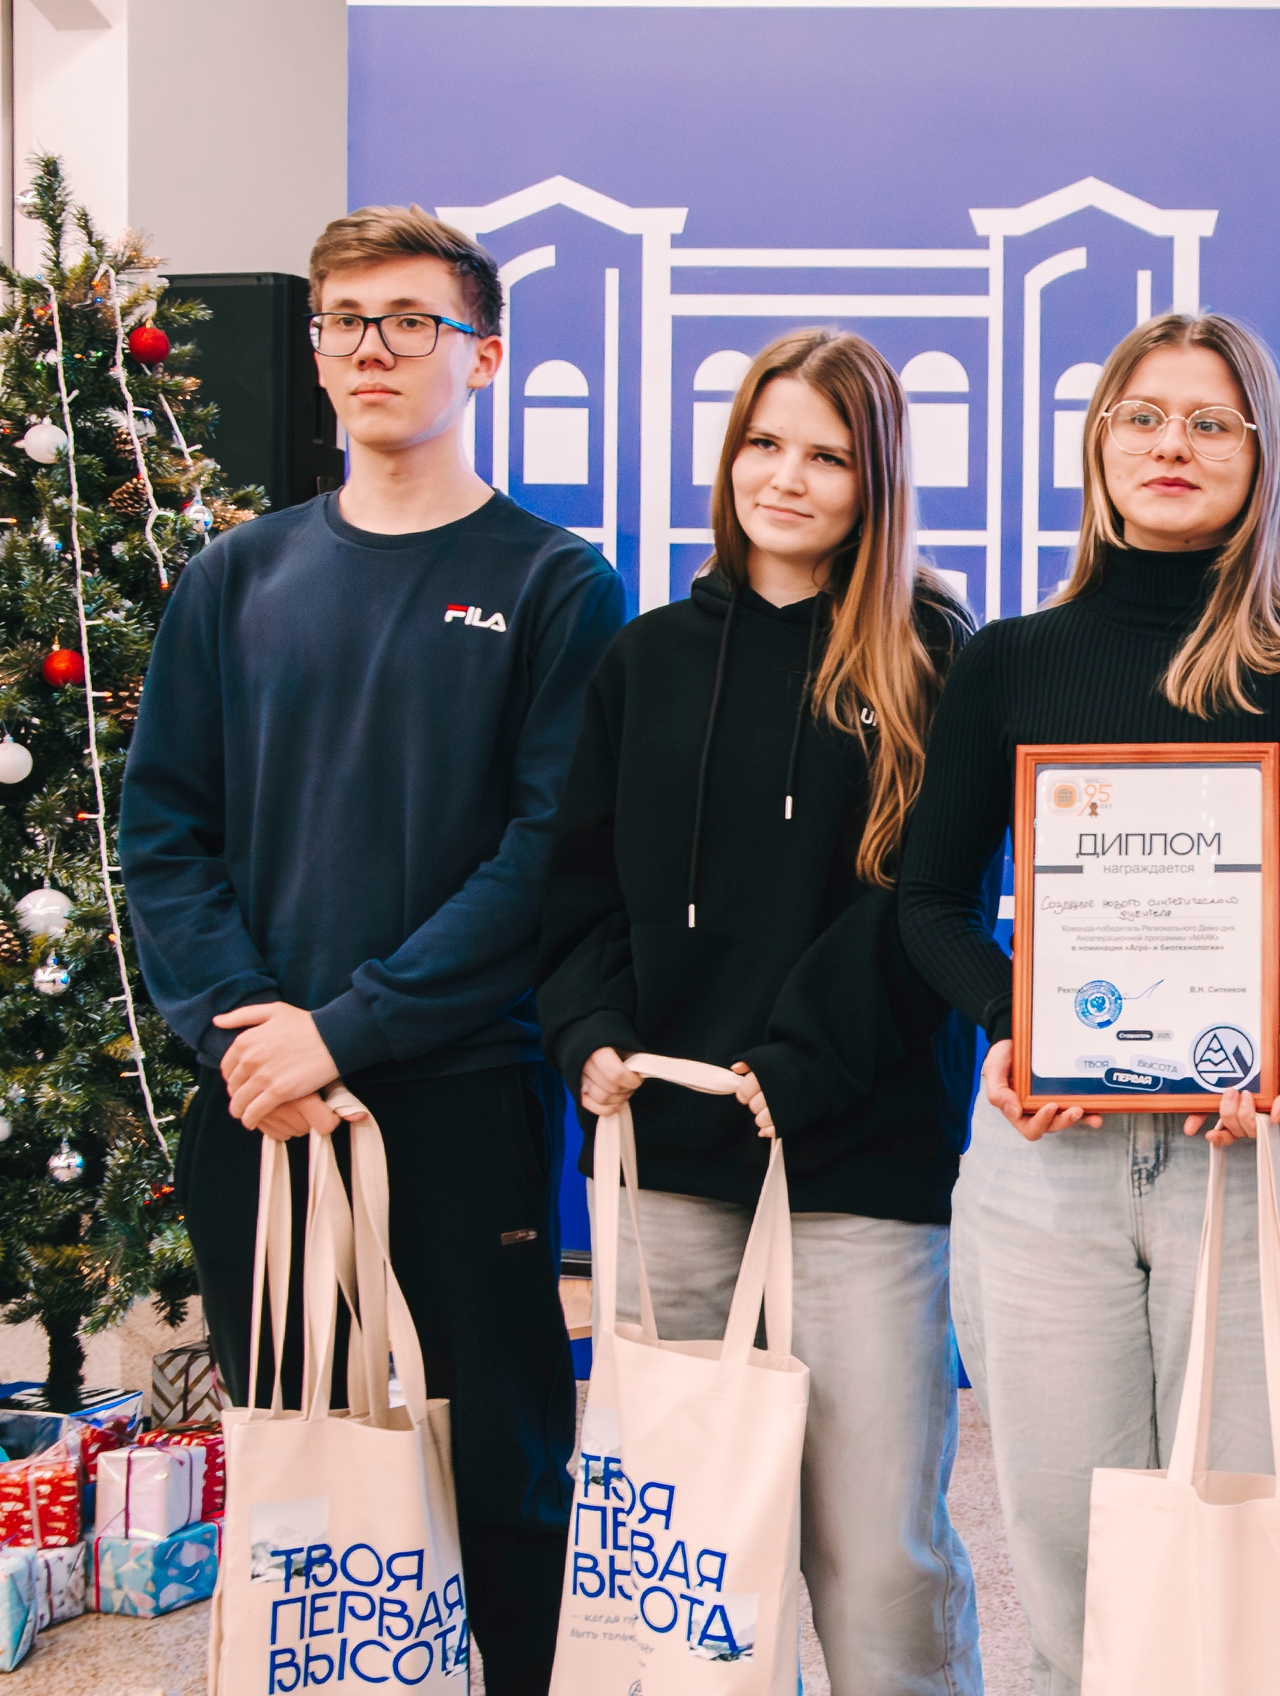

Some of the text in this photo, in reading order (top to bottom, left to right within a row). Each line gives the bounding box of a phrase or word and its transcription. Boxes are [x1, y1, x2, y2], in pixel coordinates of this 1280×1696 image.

[444, 603, 507, 633] FILA
[1075, 832, 1222, 858] ДИПЛОМ
[1103, 863, 1195, 876] награждается
[1041, 895, 1095, 915] Создание
[1102, 898, 1141, 909] нового
[1061, 924, 1235, 932] Команда-победитель Регионального Демо-дня
[1083, 1060, 1110, 1069] ТВОЯ
[1137, 1059, 1178, 1074] ВЫСОТА
[1112, 1072, 1153, 1085] ПЕРВАЯ
[270, 1543, 425, 1593] ТВОЯ
[270, 1573, 465, 1645] ПЕРВАЯ
